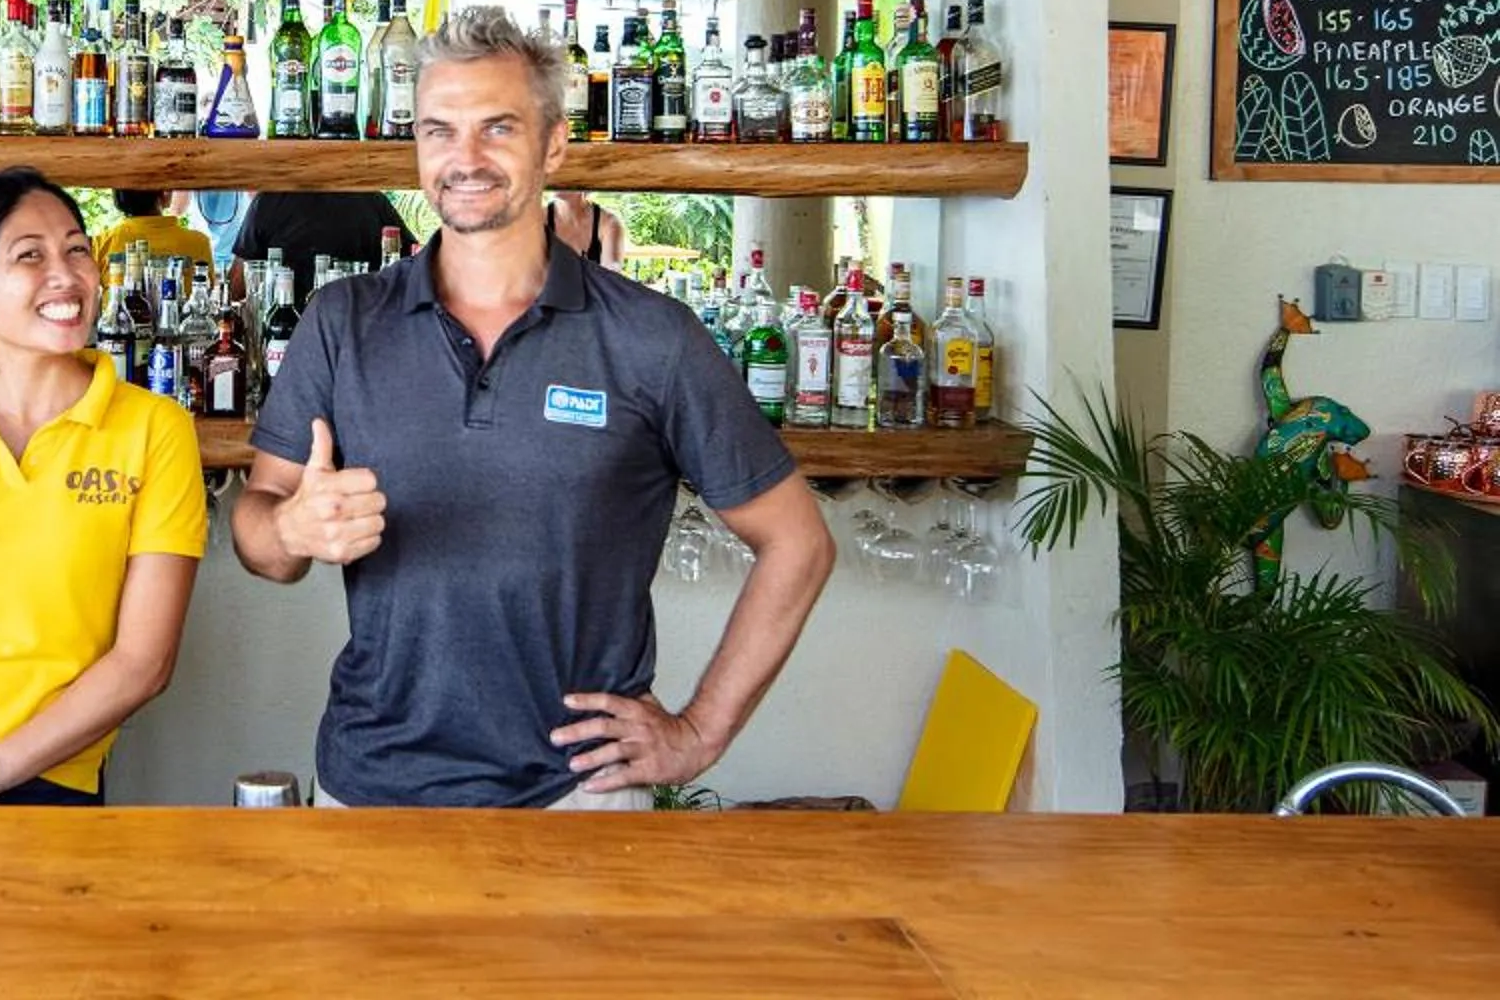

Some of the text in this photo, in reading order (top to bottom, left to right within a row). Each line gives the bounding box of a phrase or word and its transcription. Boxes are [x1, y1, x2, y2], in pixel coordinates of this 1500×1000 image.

[1317, 8, 1413, 32] 155 165
[1324, 64, 1432, 91] 165 185
[1388, 95, 1488, 119] ORANGE
[1413, 125, 1457, 146] 210
